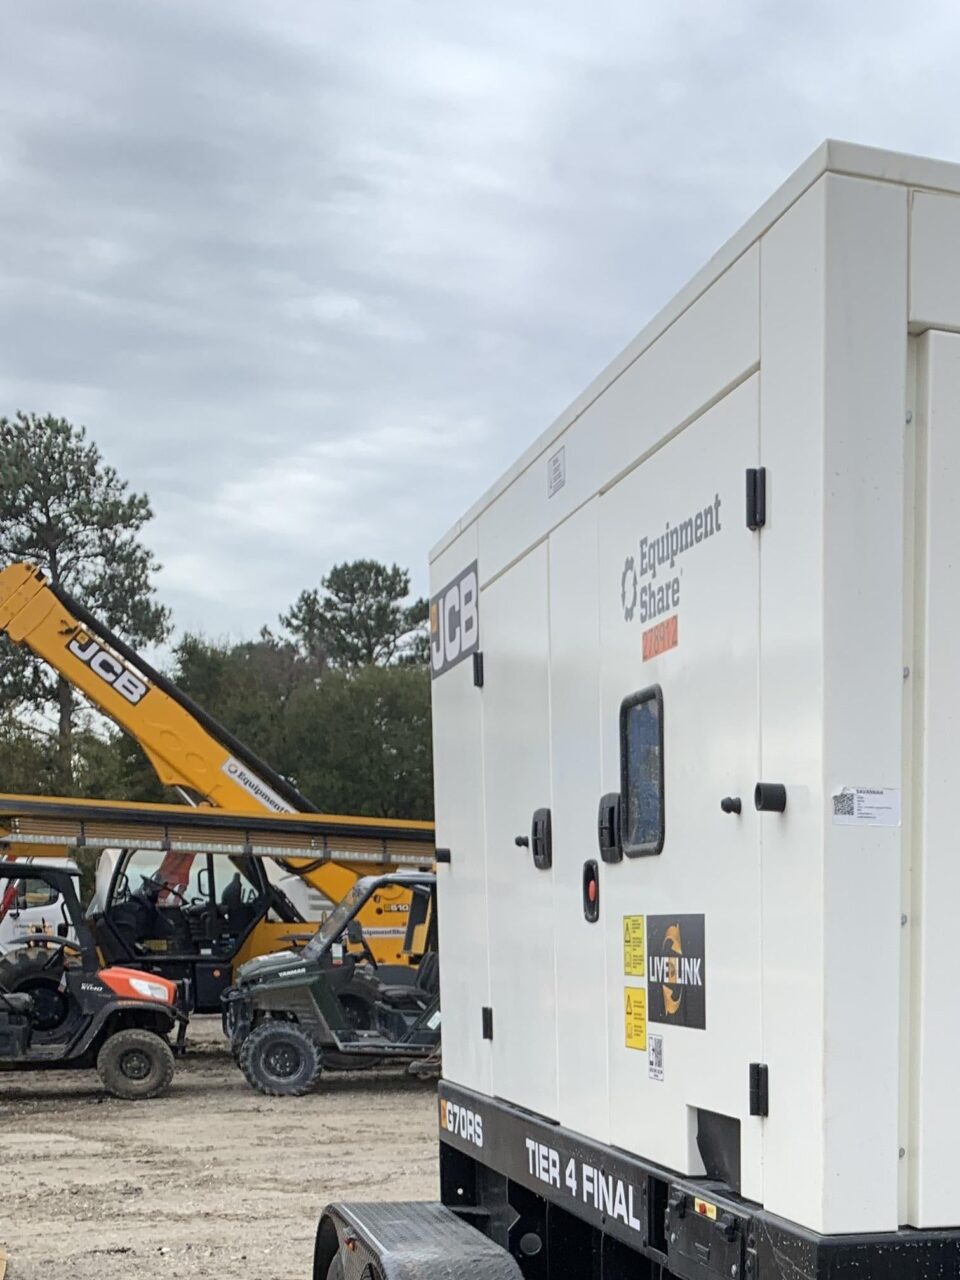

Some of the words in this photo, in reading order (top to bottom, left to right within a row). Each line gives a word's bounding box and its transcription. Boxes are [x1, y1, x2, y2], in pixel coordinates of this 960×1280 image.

[639, 492, 722, 578] Equipment
[430, 571, 479, 672] JCB
[639, 576, 681, 624] Share
[69, 638, 148, 704] JCB
[649, 956, 669, 983] LIVE
[676, 957, 702, 986] LINK
[446, 1101, 483, 1148] G70RS
[526, 1138, 560, 1189] TIER
[565, 1158, 577, 1197] 4
[582, 1163, 641, 1232] FINAL
